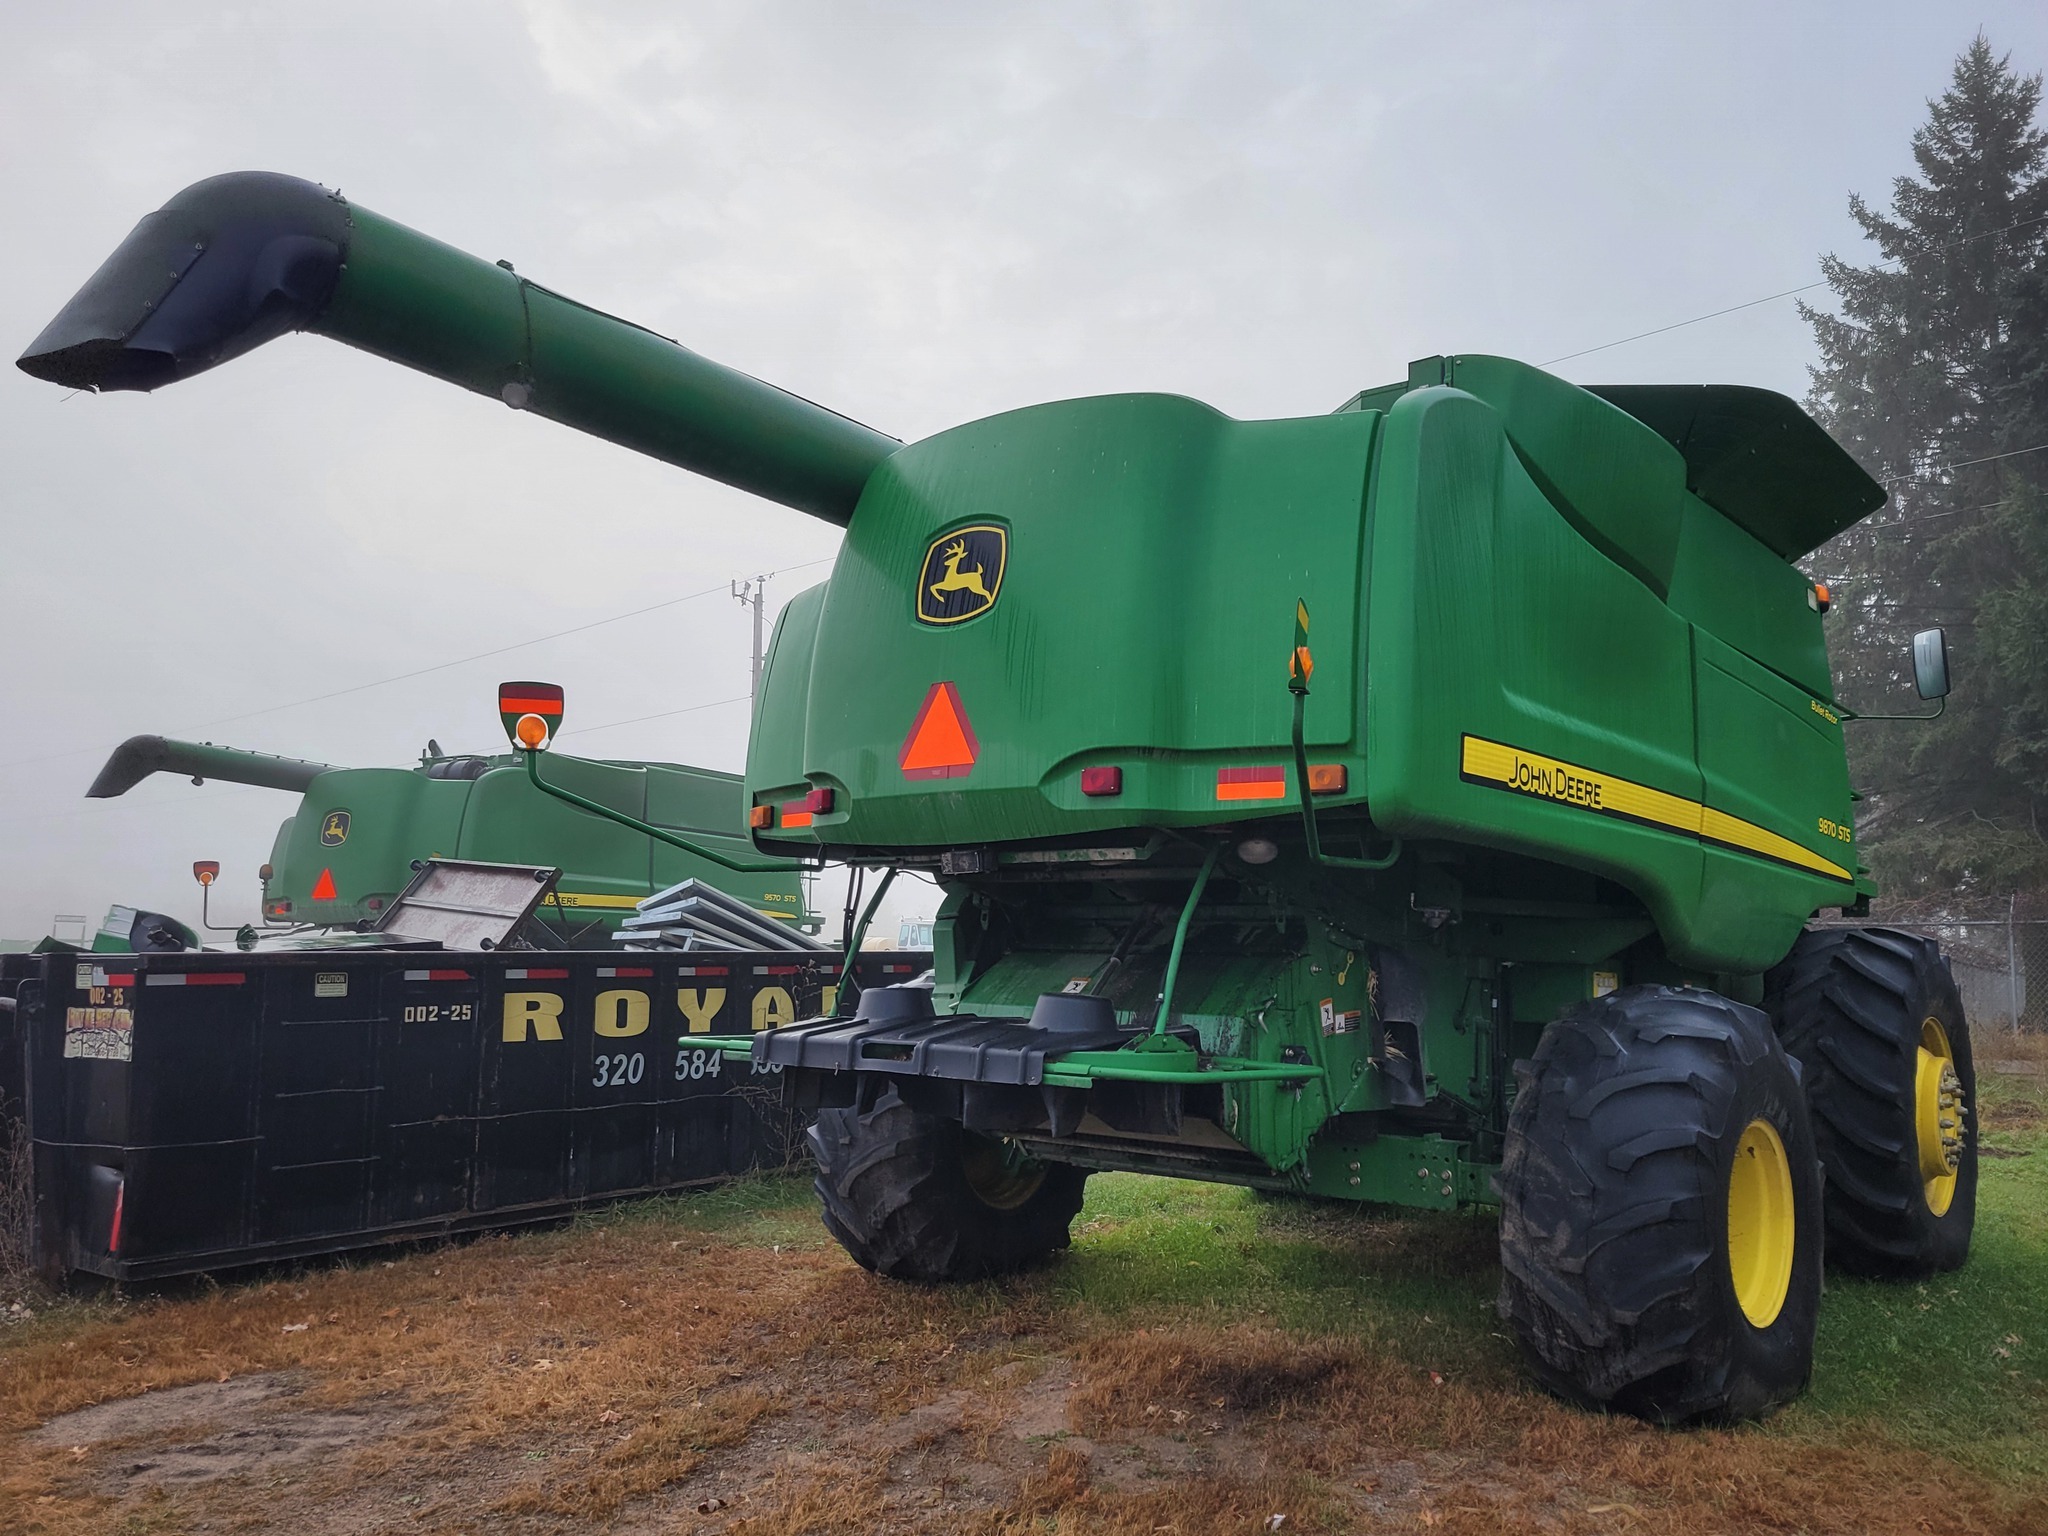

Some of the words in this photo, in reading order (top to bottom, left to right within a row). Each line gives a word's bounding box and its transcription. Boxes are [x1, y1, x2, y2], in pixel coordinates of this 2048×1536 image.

[1508, 755, 1552, 794] JOHN
[1555, 767, 1603, 806] DEERE
[1818, 817, 1837, 838] 9870
[1838, 825, 1851, 843] STS
[548, 894, 579, 906] DERE
[783, 895, 797, 903] STS
[318, 974, 346, 984] CAUTION
[592, 1052, 646, 1088] 320
[674, 1048, 722, 1081] 584
